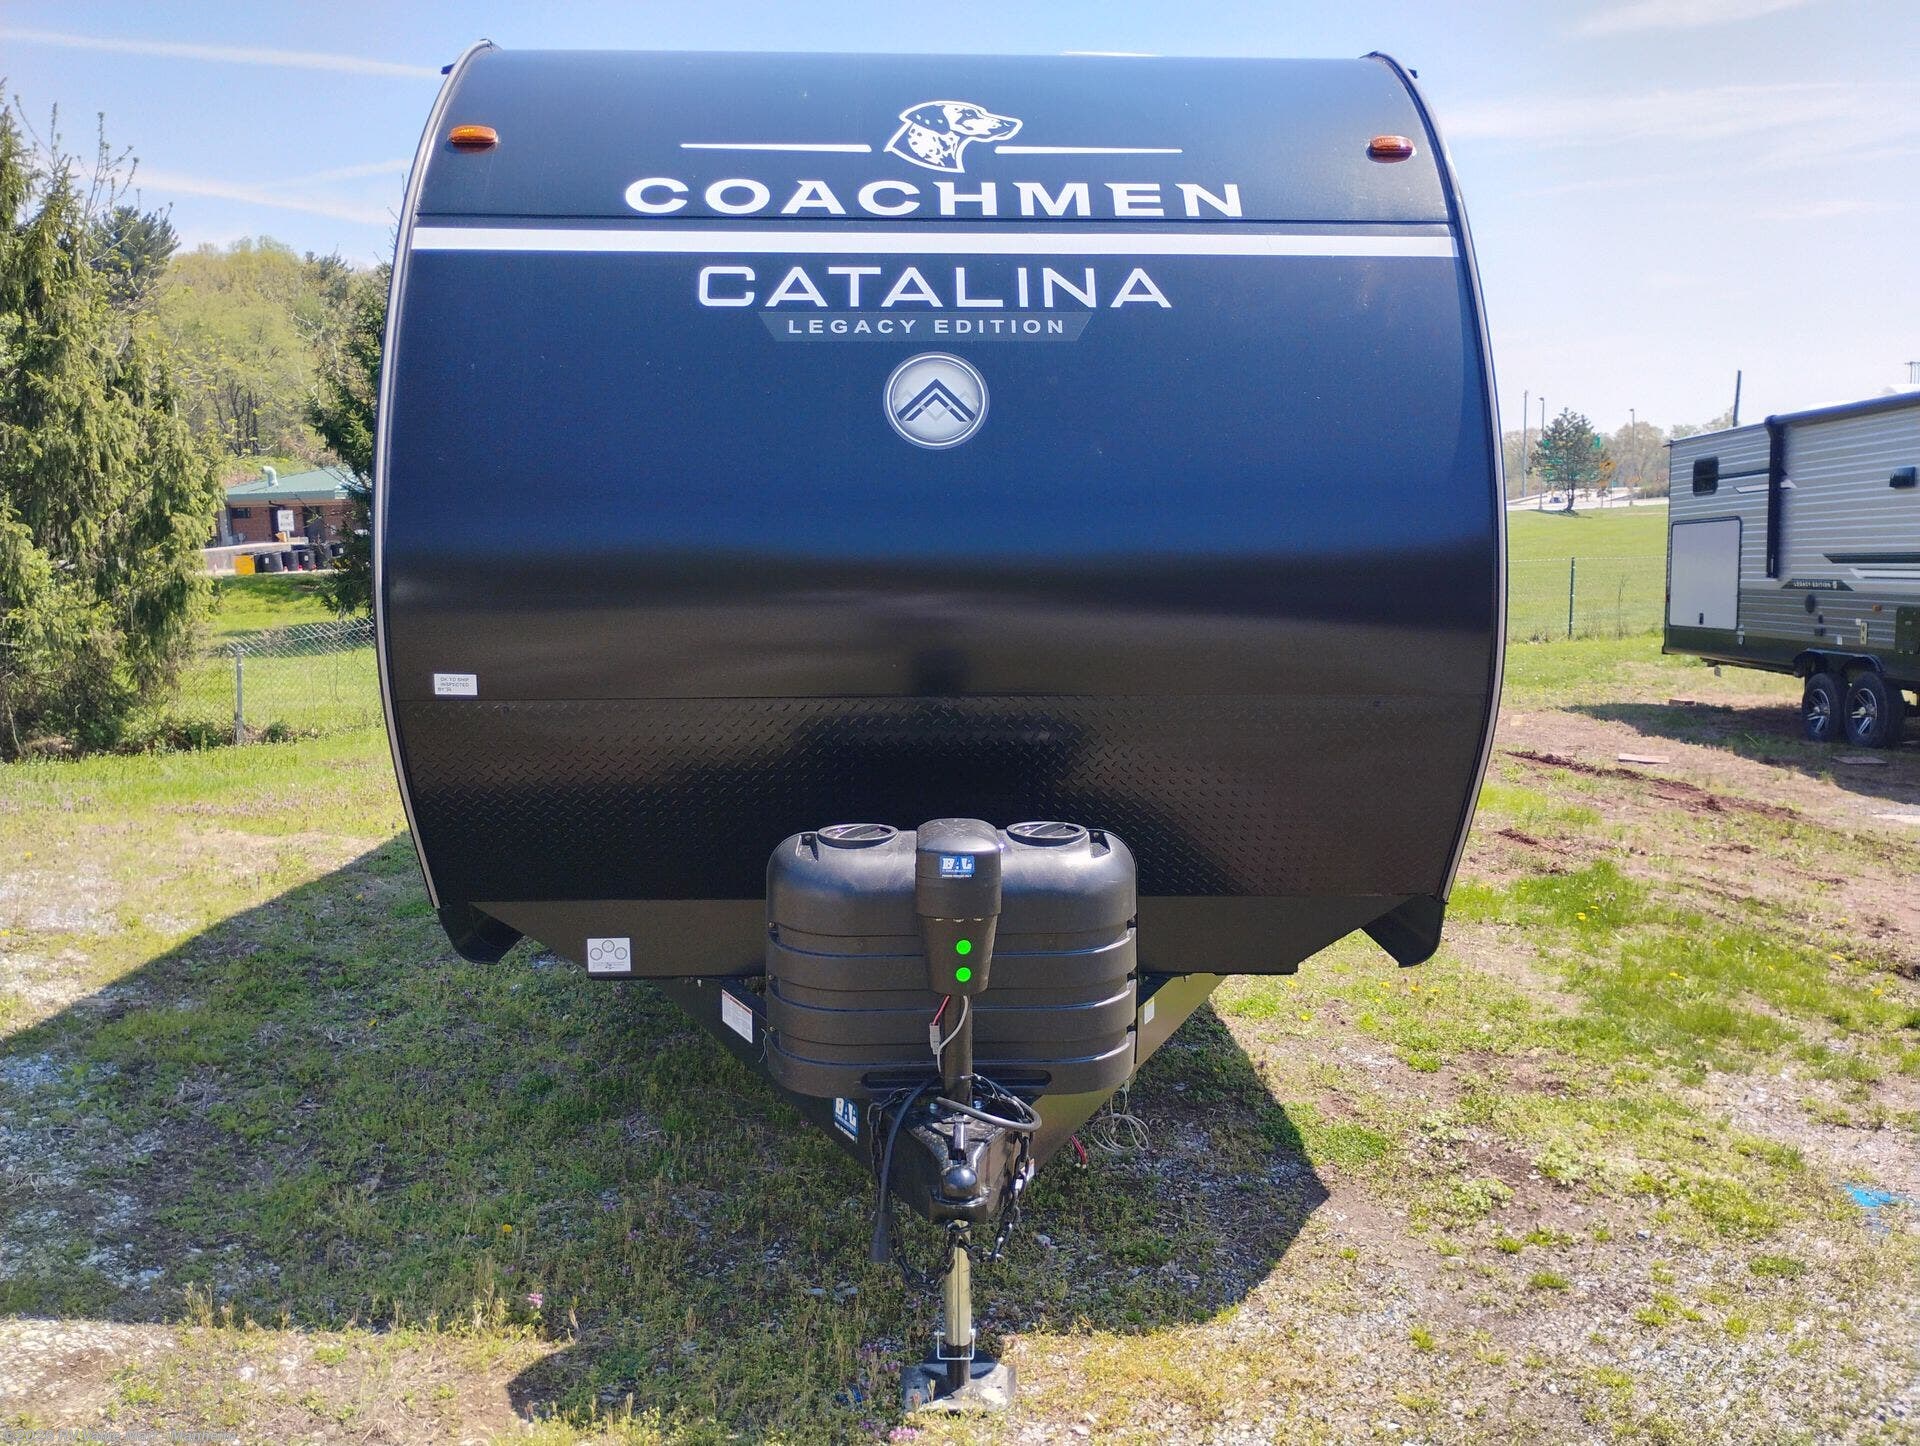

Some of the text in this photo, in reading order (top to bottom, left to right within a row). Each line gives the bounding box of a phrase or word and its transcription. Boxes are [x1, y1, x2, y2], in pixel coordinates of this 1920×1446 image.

[625, 177, 1243, 218] COACHMEN
[698, 265, 1172, 308] CATALINA
[788, 319, 1065, 334] LEGACY EDITION
